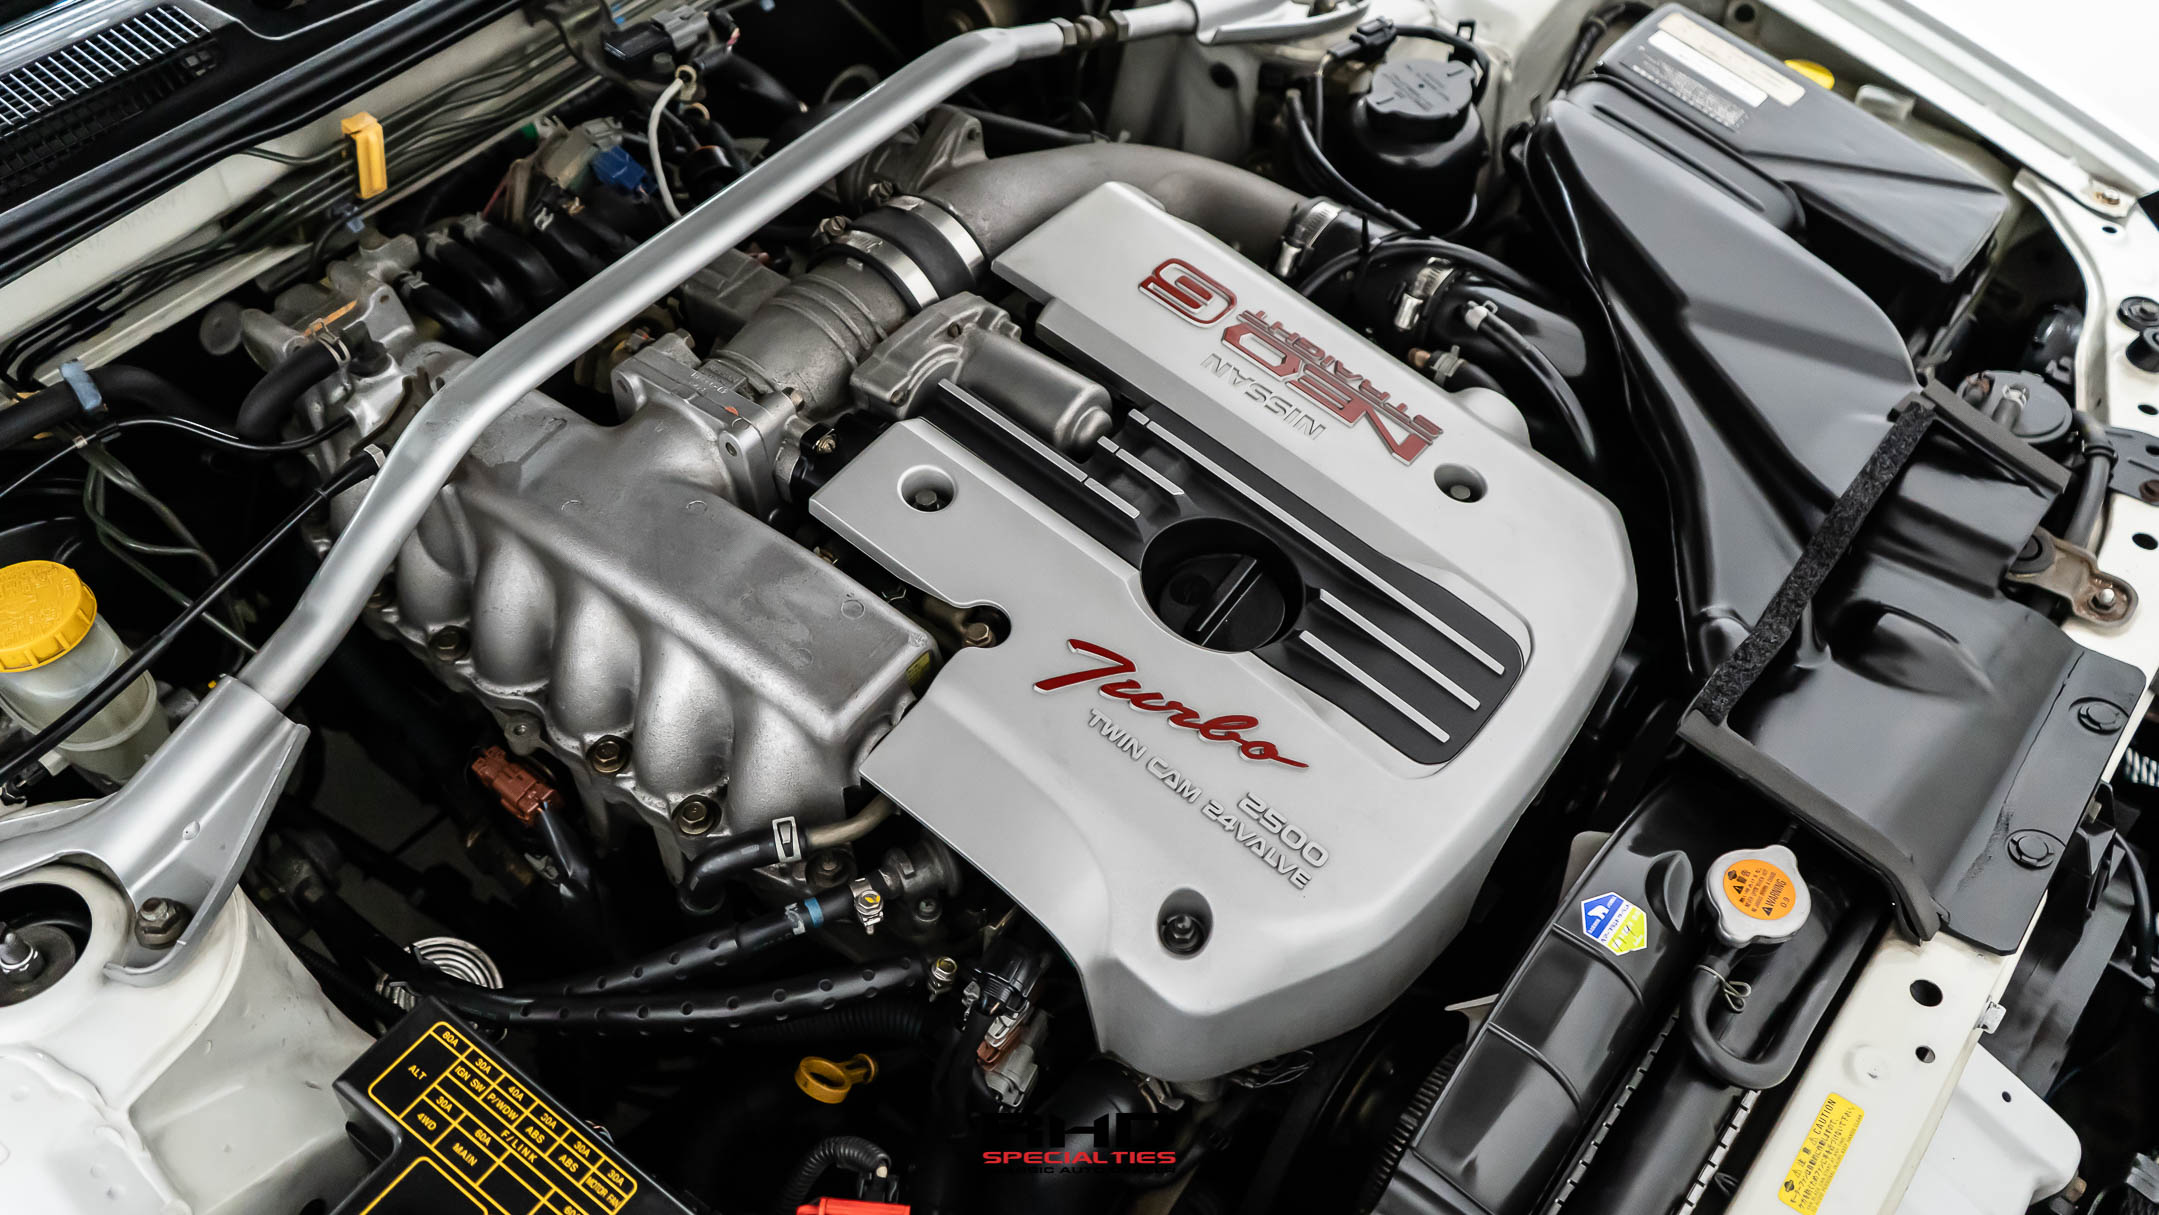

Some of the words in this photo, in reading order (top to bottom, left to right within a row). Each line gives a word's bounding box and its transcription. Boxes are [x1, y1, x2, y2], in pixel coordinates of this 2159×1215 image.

[1138, 258, 1237, 328] 6
[1238, 310, 1444, 438] STRAIGHT
[1200, 353, 1326, 440] NISSAN
[1221, 322, 1432, 466] NEO
[1033, 638, 1309, 768] Turbo
[1088, 708, 1148, 762] TWIN
[1146, 756, 1202, 803] CAM
[1201, 800, 1312, 890] 24VALVE
[1237, 792, 1329, 868] 2500
[1765, 878, 1787, 907] WARNING
[408, 1064, 427, 1080] ALT
[454, 1065, 471, 1081] IGN
[469, 1078, 486, 1093] SW
[475, 1058, 492, 1074] 30A
[436, 1096, 453, 1113] 30A
[487, 1092, 519, 1120] P/WDW
[508, 1085, 525, 1101] 40A
[417, 1112, 437, 1131] 4WD
[540, 1112, 557, 1129] 30A
[1812, 1098, 1837, 1135] CAUTION
[501, 1129, 538, 1163] F/LINK
[525, 1126, 545, 1144] ABS
[452, 1142, 478, 1166] MAIN
[573, 1140, 591, 1158] 30A
[558, 1154, 579, 1173] ABS
[607, 1169, 625, 1187] 30A
[606, 1193, 620, 1209] FAN
